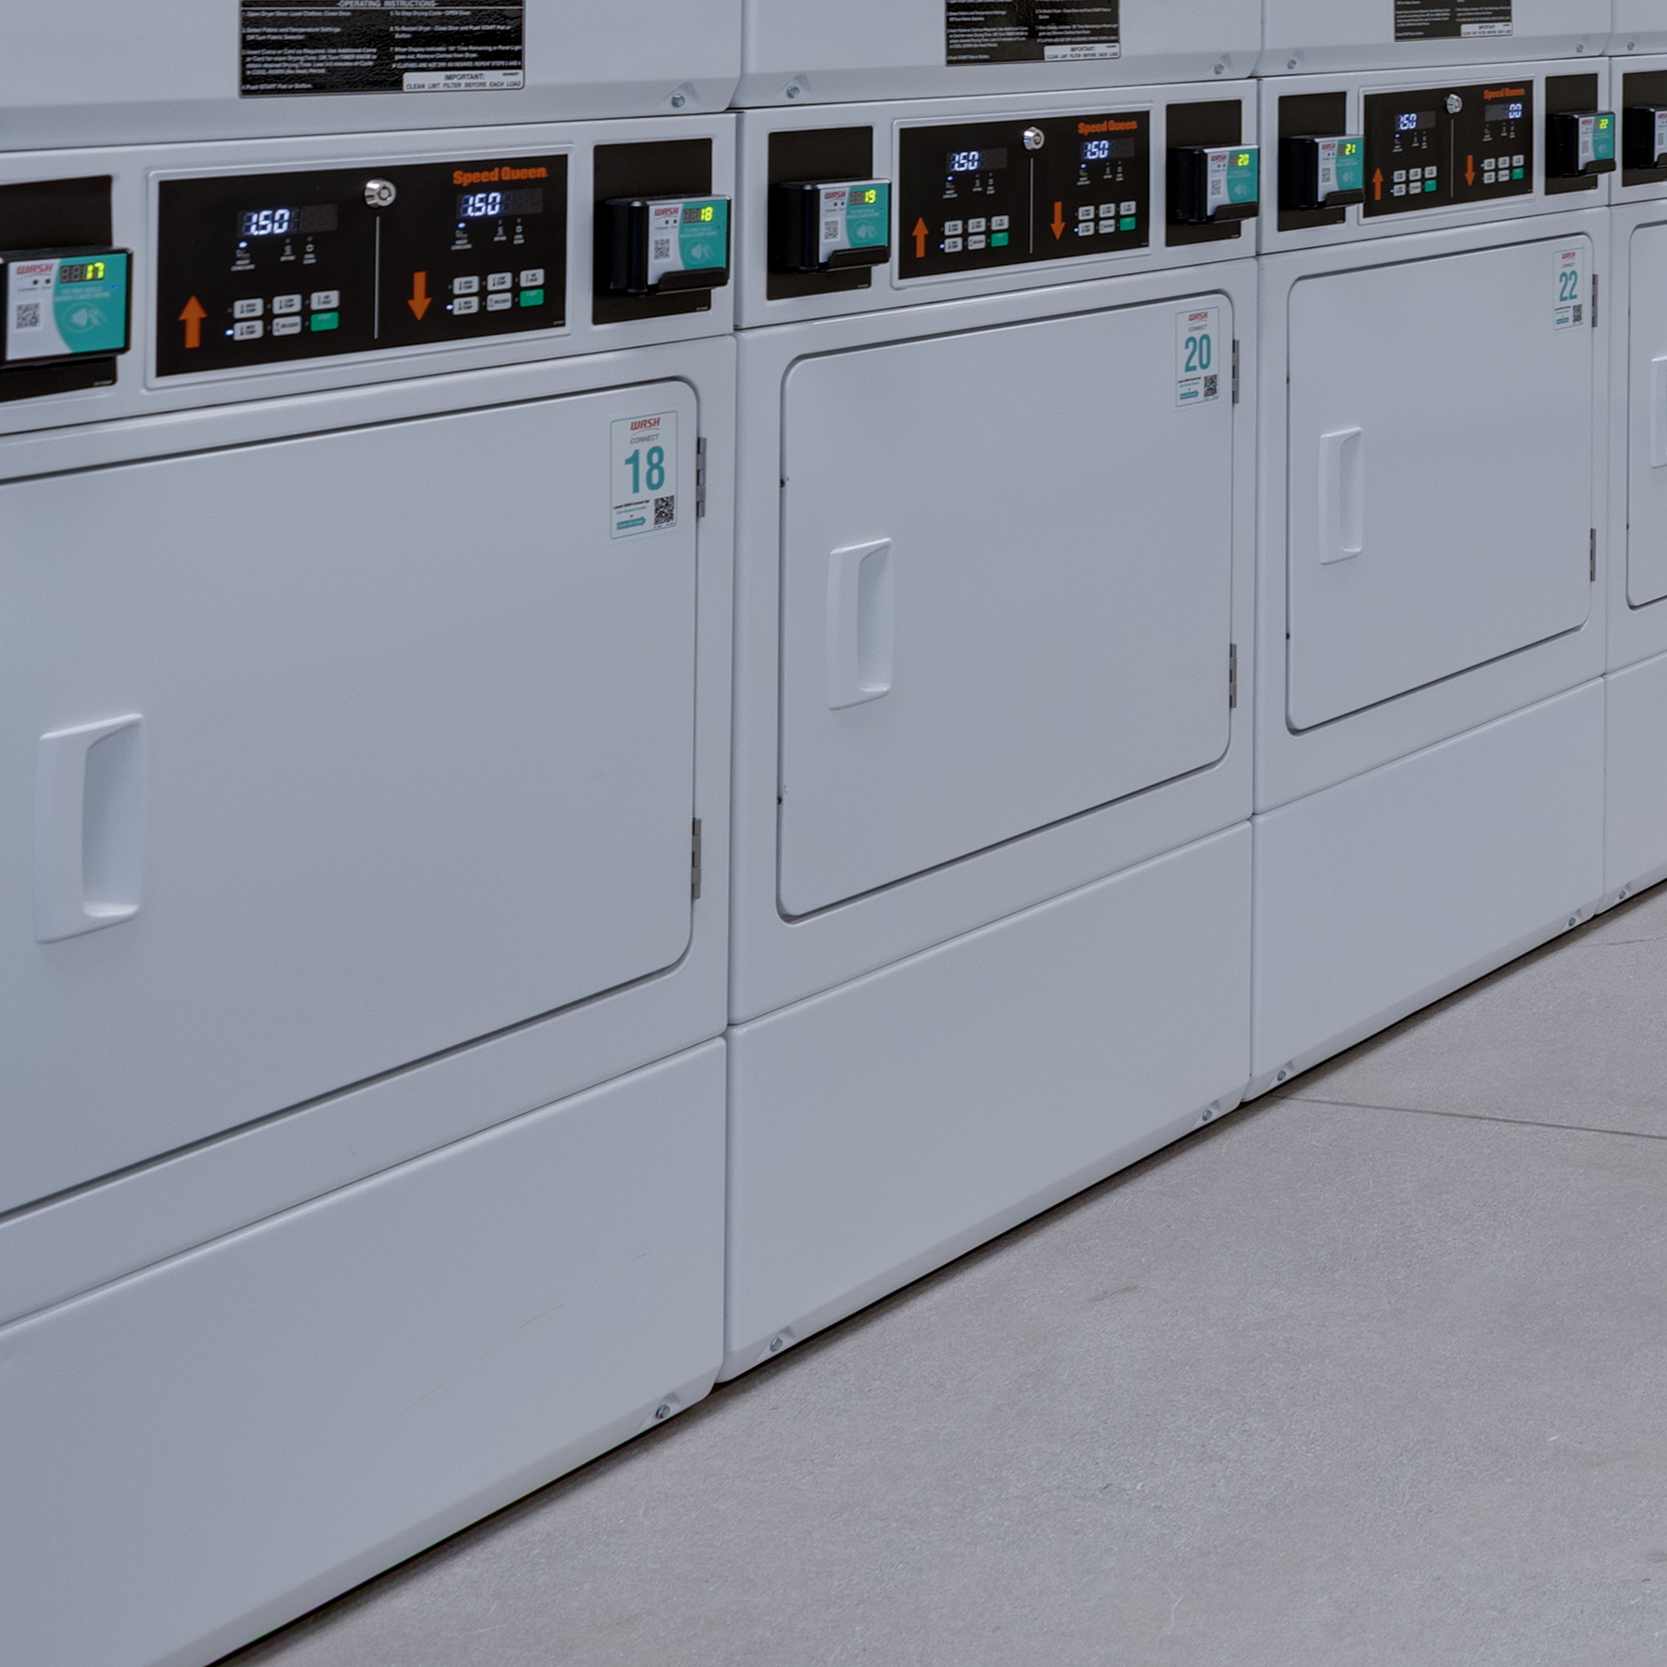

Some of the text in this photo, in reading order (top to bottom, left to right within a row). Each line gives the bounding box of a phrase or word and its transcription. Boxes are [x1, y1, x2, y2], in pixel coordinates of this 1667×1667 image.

[444, 73, 486, 81] IMPORTANT:
[1078, 120, 1138, 136] Speed Queen
[453, 166, 547, 186] Speed Queen
[864, 189, 877, 204] 19
[654, 207, 679, 217] WASH
[700, 206, 714, 222] 18
[16, 263, 54, 276] WASH
[86, 262, 106, 280] 17
[1559, 270, 1578, 302] 22
[1184, 333, 1211, 373] 20
[630, 417, 661, 431] WASH
[630, 433, 659, 445] CONNECT
[624, 445, 665, 494] 18
